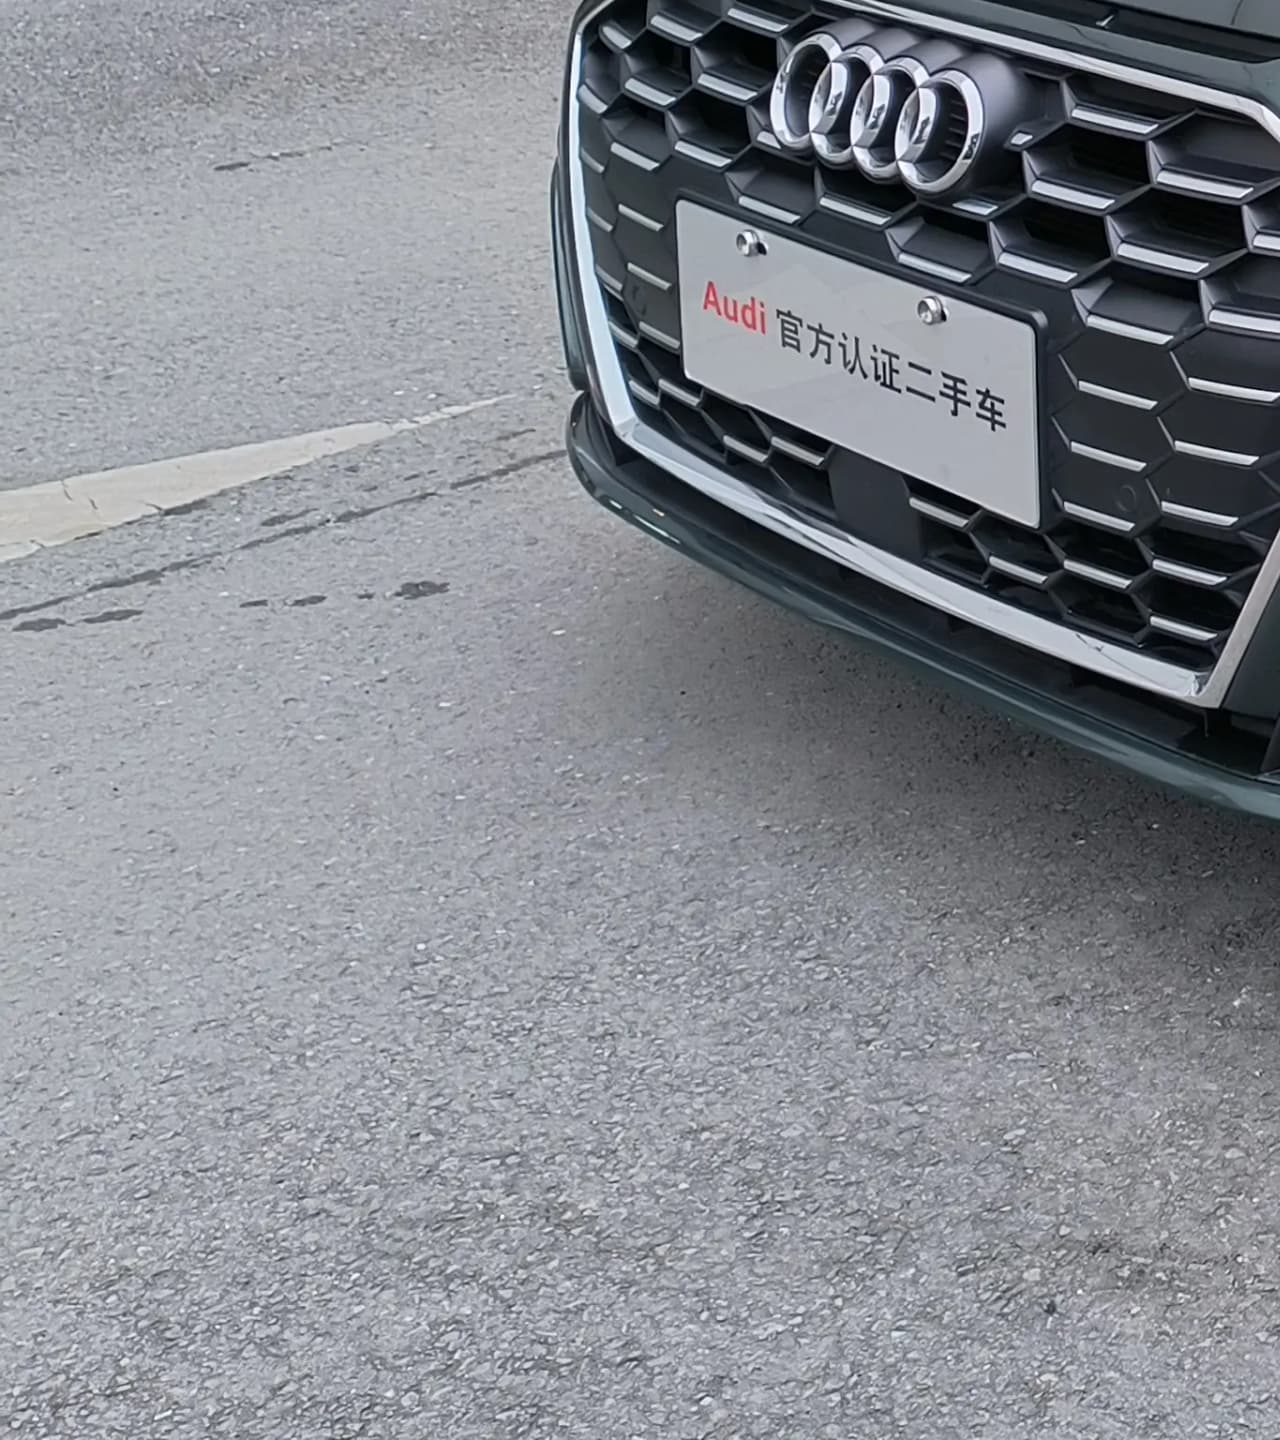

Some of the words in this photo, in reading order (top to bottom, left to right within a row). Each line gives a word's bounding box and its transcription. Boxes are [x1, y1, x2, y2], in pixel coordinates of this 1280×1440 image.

[703, 280, 767, 335] Audi
[776, 308, 1006, 432] 官方认证二手车
